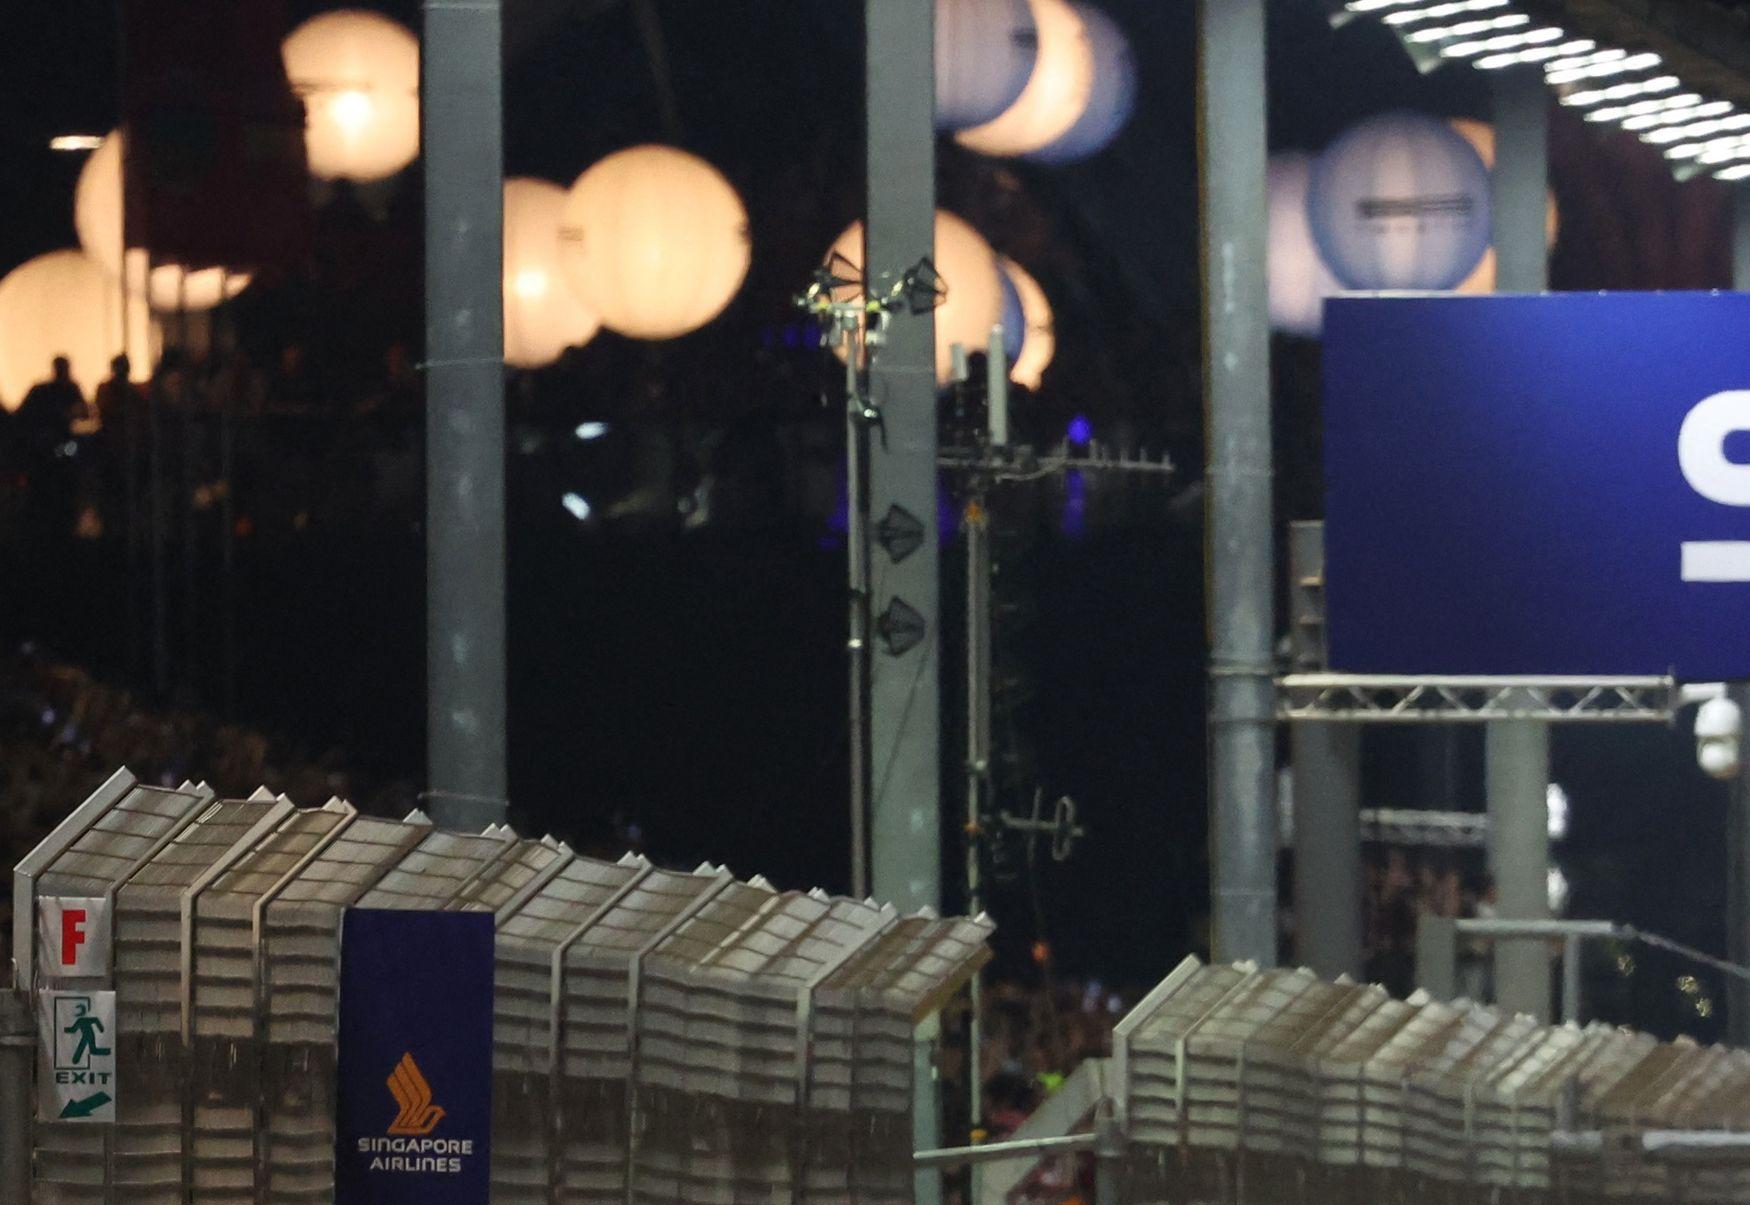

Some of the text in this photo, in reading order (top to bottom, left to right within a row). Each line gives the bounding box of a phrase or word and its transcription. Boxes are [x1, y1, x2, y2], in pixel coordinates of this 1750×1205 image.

[62, 909, 86, 965] F
[55, 1071, 112, 1085] EXIT
[358, 1138, 473, 1154] SINGAPORE
[369, 1157, 461, 1172] AIRLINES
